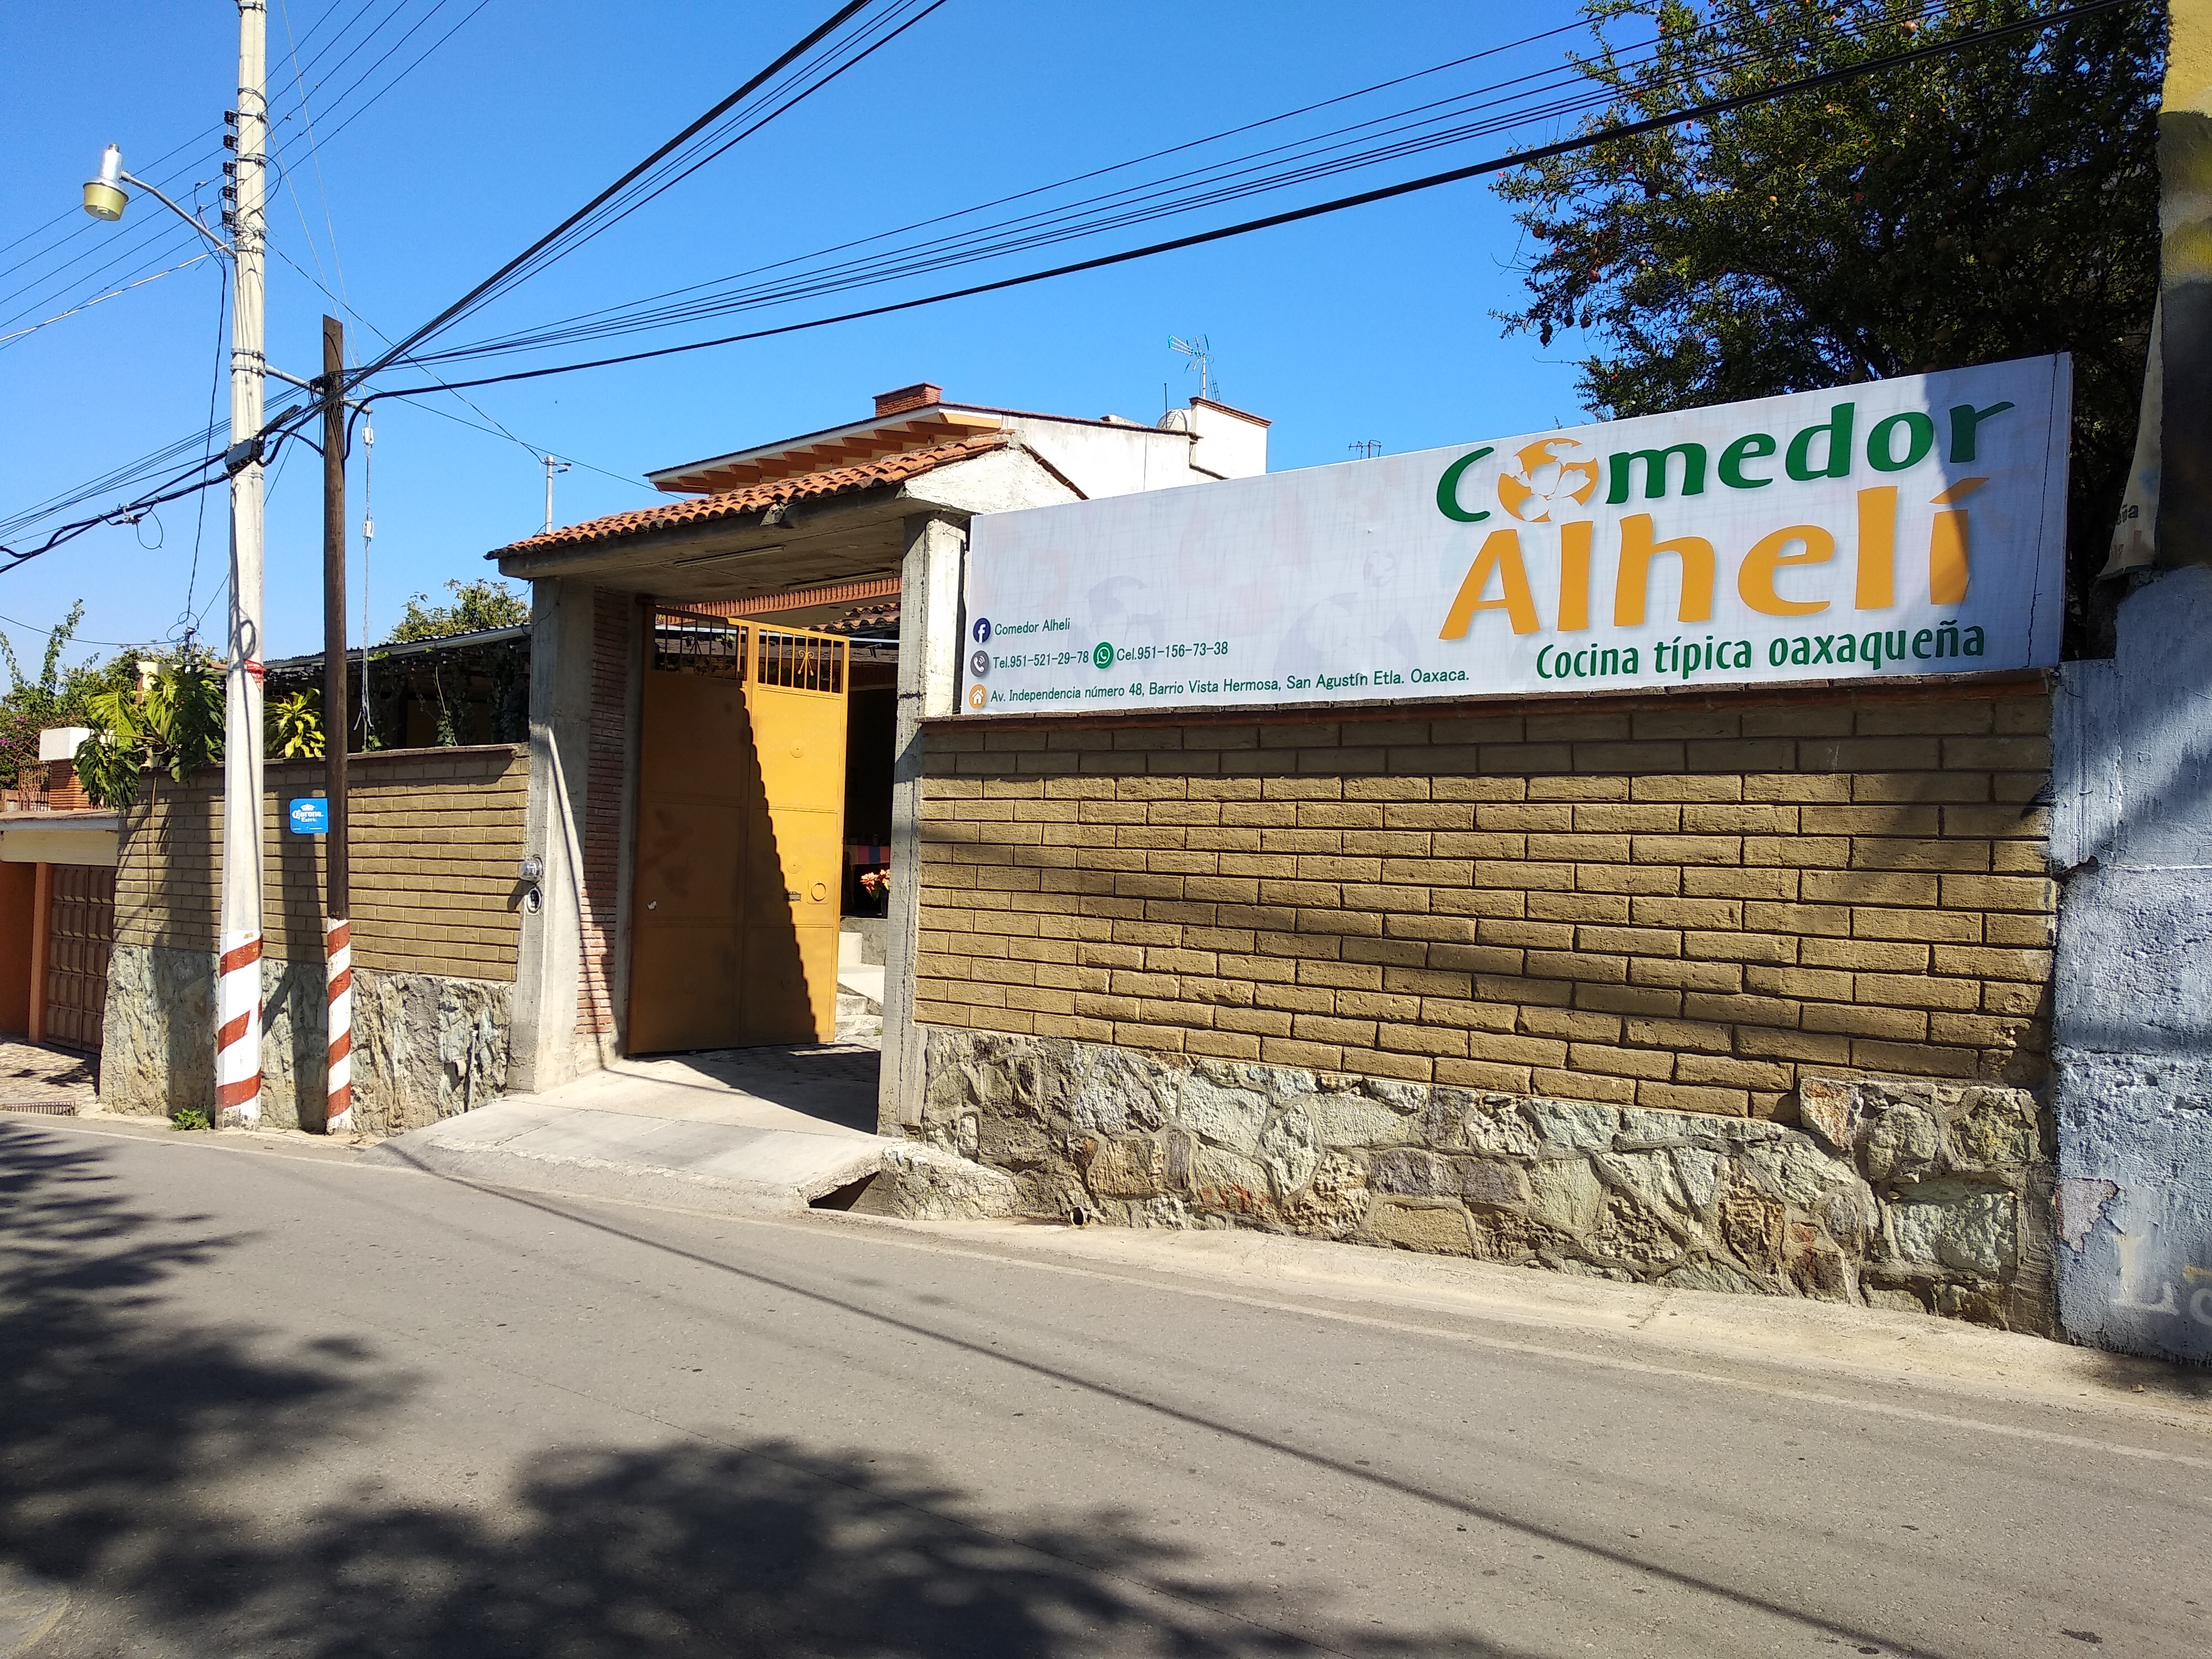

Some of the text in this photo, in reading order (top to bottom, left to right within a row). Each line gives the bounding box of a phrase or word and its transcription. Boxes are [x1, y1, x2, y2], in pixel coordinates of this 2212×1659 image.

[1437, 401, 2016, 523] Comedor
[1439, 477, 1989, 640] Alhelí
[994, 620, 1040, 635] Comedor
[993, 641, 1229, 669] Tel.951-521-29-78 Cel.951-156-73-38
[1536, 619, 1985, 680] Cocina típica oaxaqueña
[990, 668, 1470, 703] Av. Independencia número 48, Barrio Vista Hermosa, San Agustín Etla. Oaxaca.
[292, 810, 322, 820] Corona
